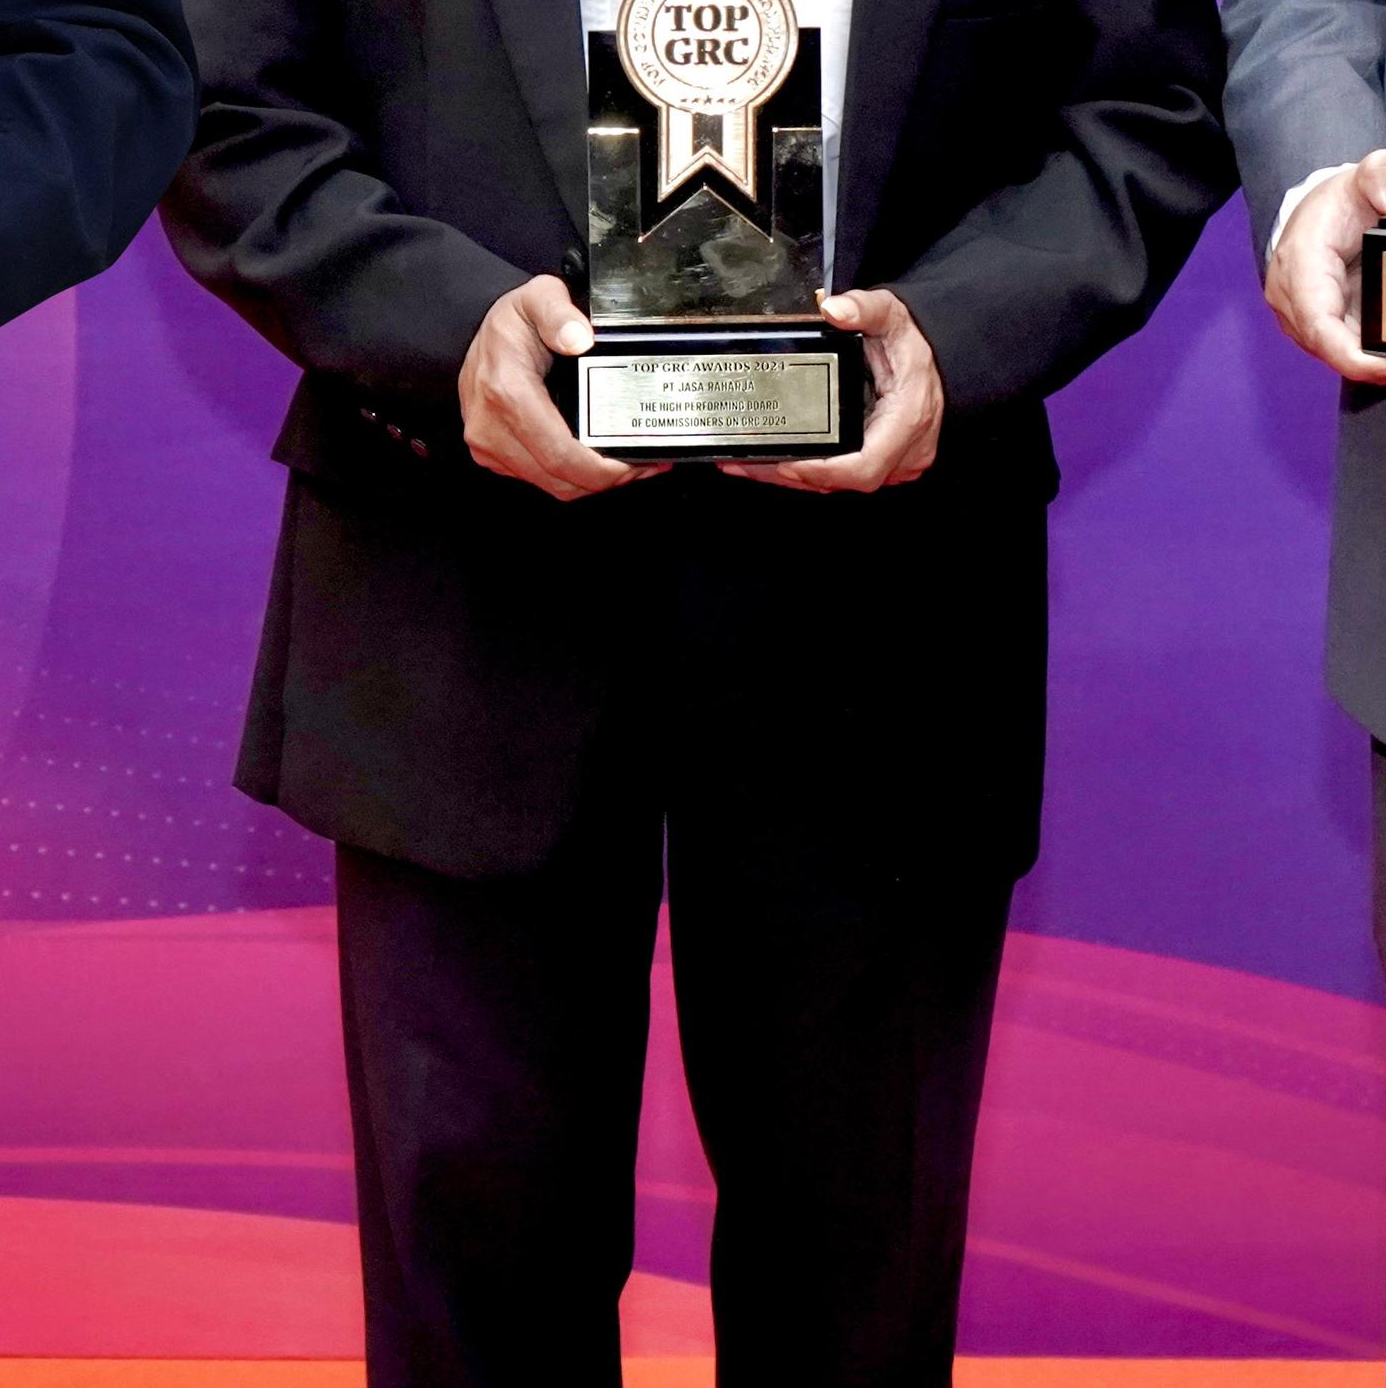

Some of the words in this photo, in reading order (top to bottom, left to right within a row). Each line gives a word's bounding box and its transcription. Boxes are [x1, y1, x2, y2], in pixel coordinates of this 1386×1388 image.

[665, 4, 749, 32] TOP
[664, 38, 749, 65] GRC
[632, 363, 658, 373] TOP
[663, 363, 690, 372] GRC
[693, 362, 750, 372] AWARDS
[754, 361, 785, 371] 2024
[663, 382, 674, 392] PT
[678, 382, 704, 392] JASA
[708, 381, 754, 391] RAHARJA
[640, 402, 656, 412] THE
[660, 402, 681, 412] HIGH
[685, 401, 744, 411] PERFORMING
[747, 400, 778, 410] BOARD
[632, 418, 641, 428] OF
[645, 417, 723, 427] COMMISSIONERS
[727, 417, 739, 427] ON
[742, 417, 760, 427] GRC
[763, 416, 786, 426] 2024
